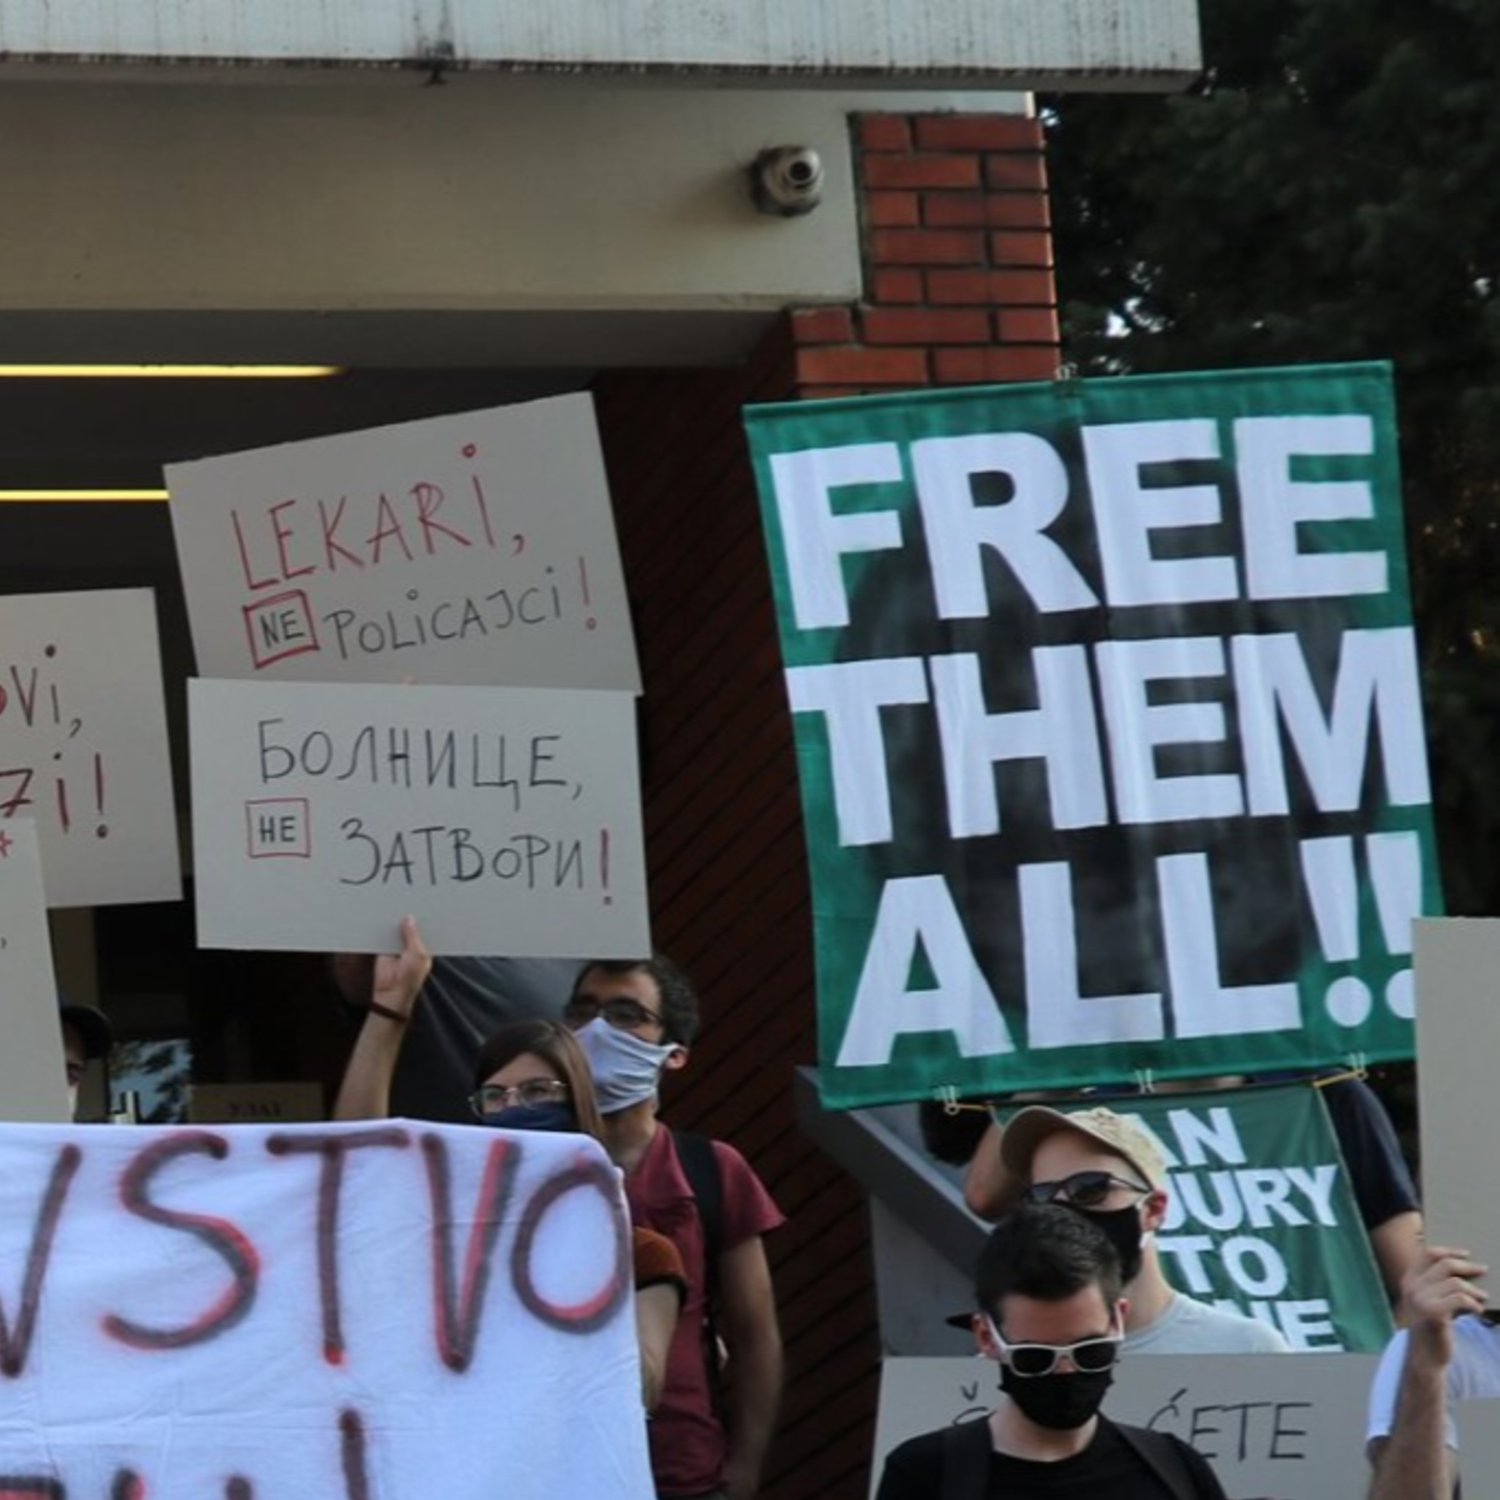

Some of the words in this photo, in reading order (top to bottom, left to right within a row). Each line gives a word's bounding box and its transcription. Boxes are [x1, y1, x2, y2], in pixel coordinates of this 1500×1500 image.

[768, 415, 1389, 631] FREE
[260, 610, 304, 649] NE
[257, 719, 584, 811] БОЛНИЦЕ,
[784, 626, 1432, 848] THEM
[339, 817, 613, 906] ЗАТВОРИ!
[836, 831, 1423, 1067] ALL!!
